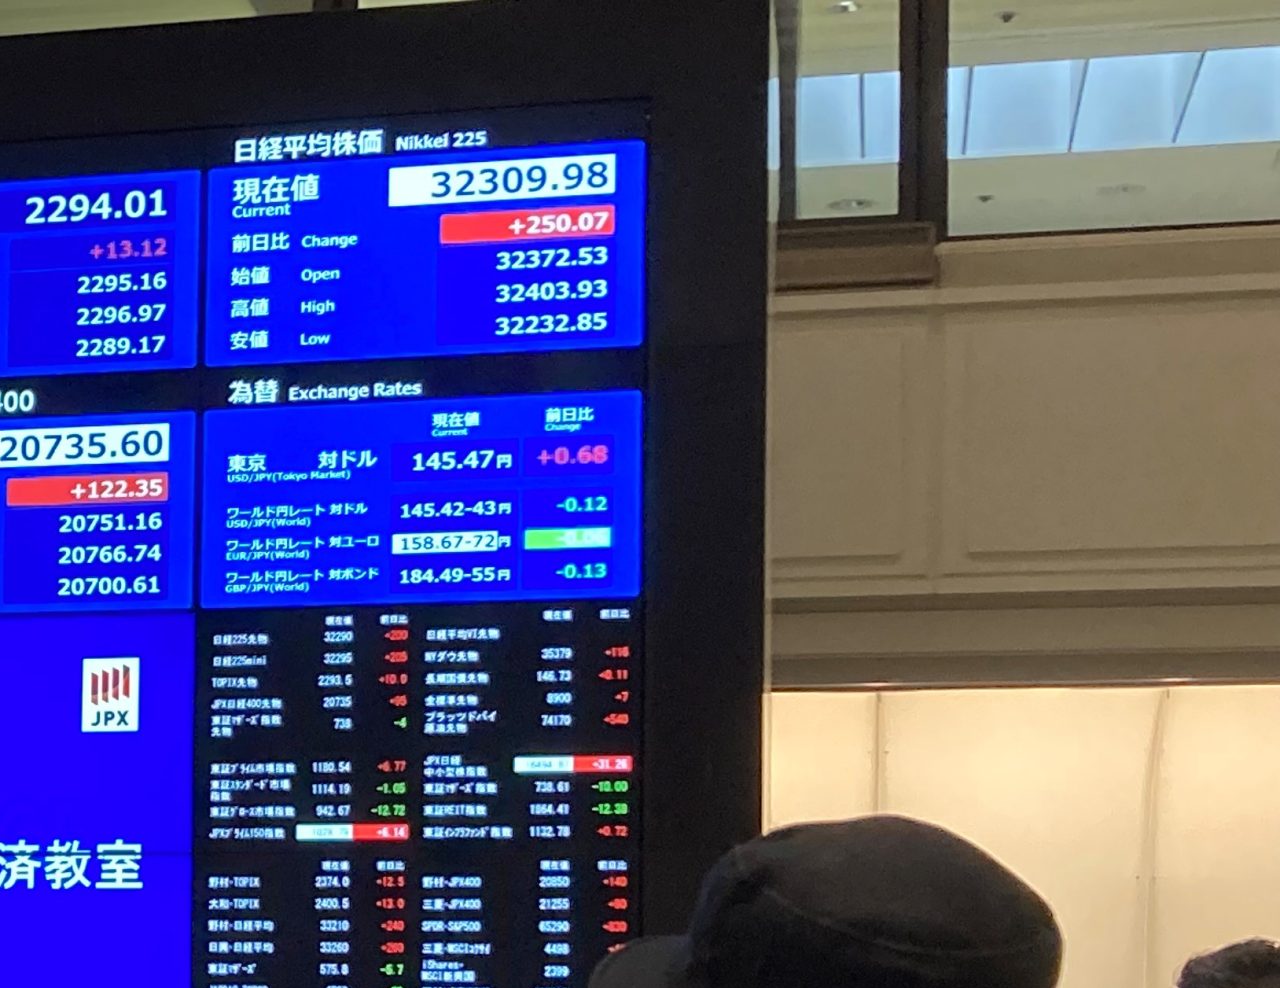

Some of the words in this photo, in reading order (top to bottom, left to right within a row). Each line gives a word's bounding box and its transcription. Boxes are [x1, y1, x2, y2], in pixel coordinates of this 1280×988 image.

[234, 129, 384, 162] 日経平均株価
[395, 133, 450, 152] Nikkei
[452, 130, 487, 148] 225
[232, 173, 320, 205] 現在値
[431, 161, 608, 198] 32309.98
[25, 188, 168, 225] 2294.01
[231, 202, 291, 219] Current
[231, 231, 290, 253] 前日比
[300, 234, 359, 249] Change
[508, 211, 610, 235] +250.07
[90, 237, 167, 260] +13.12
[230, 266, 270, 286] 始値
[300, 268, 341, 284] Open
[495, 245, 609, 271] 32372.53
[77, 271, 168, 294] 2295.16
[230, 298, 270, 318] 高値
[300, 299, 336, 316] High
[495, 279, 608, 304] 32403.93
[76, 303, 167, 326] 2296.97
[229, 330, 269, 350] 安値
[299, 333, 331, 346] Low
[494, 311, 608, 336] 32232.85
[75, 335, 166, 357] 2289.17
[227, 378, 280, 405] 為替
[288, 384, 370, 402] Exchange
[373, 381, 423, 397] Rates
[432, 411, 480, 429] 現在値
[545, 406, 595, 424] 前日比
[0, 430, 163, 462] 20735.60
[227, 453, 267, 473] 東京
[317, 449, 378, 470] 対ドル
[70, 478, 163, 500] +122.35
[226, 503, 326, 519] ワールド円レート
[329, 502, 369, 516] 対ドル
[556, 495, 608, 513] -0.12
[58, 511, 163, 533] 20751.16
[58, 543, 162, 565] 20766.74
[226, 536, 325, 551] ワールド円レート
[328, 534, 380, 548] 対ユーロ
[225, 568, 325, 584] ワールド円レート
[555, 562, 608, 579] -0.13
[57, 575, 161, 596] 20700.61
[91, 710, 129, 727] JPX
